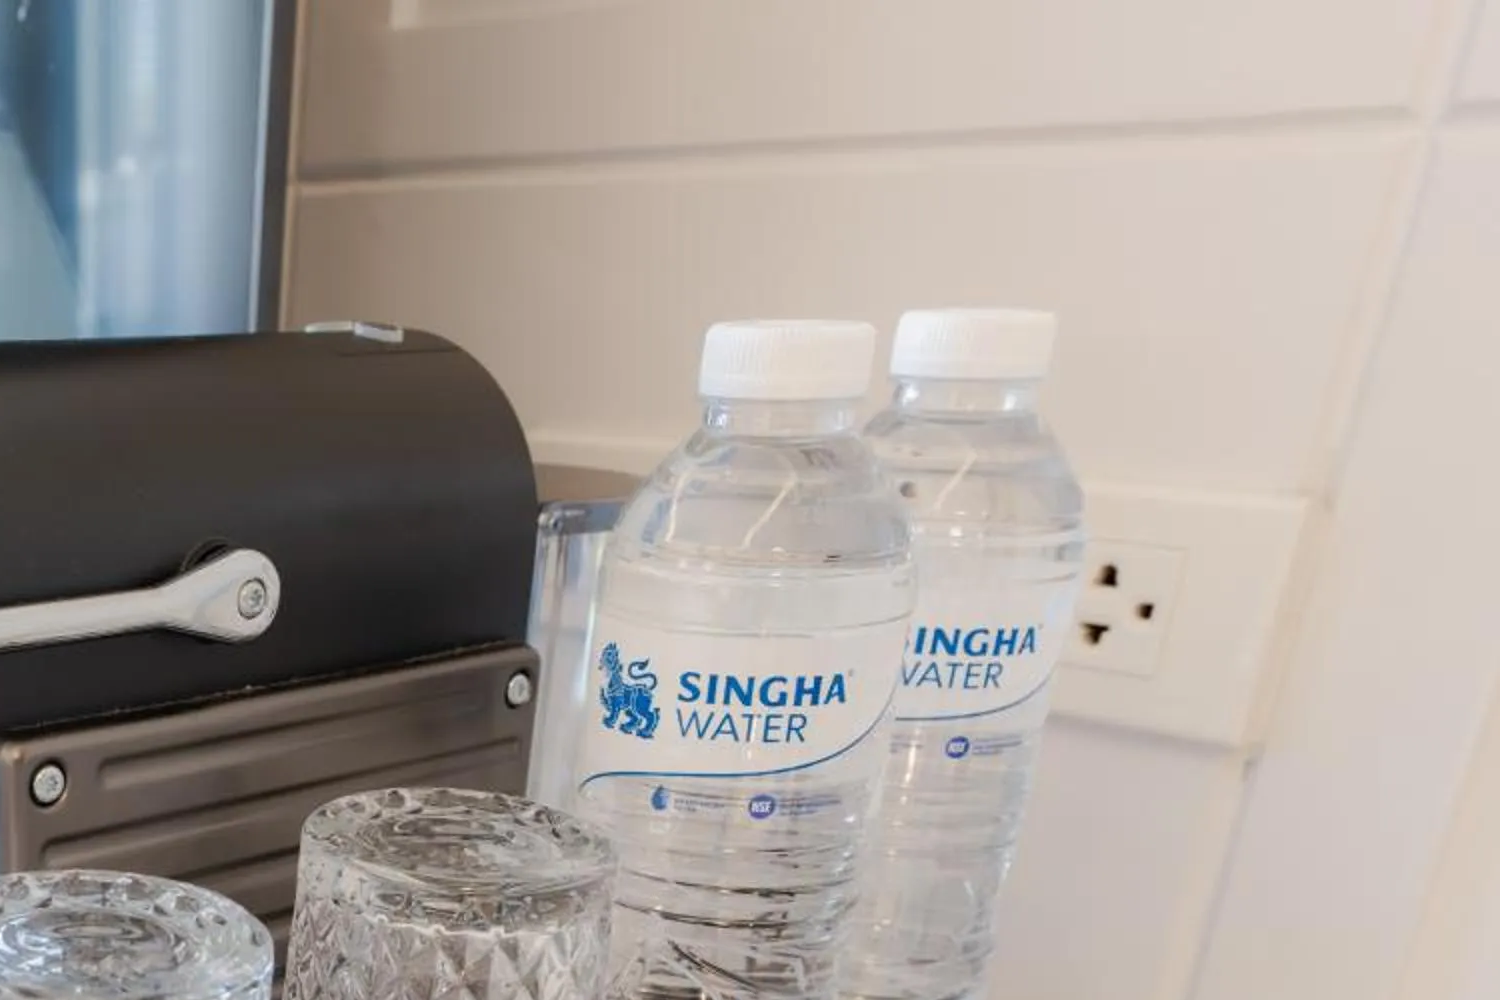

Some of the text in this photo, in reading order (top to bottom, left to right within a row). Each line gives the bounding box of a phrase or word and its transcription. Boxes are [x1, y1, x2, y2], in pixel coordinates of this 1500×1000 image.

[904, 625, 1037, 657] INGHA
[676, 671, 847, 708] SINGHA
[676, 708, 808, 744] WATER
